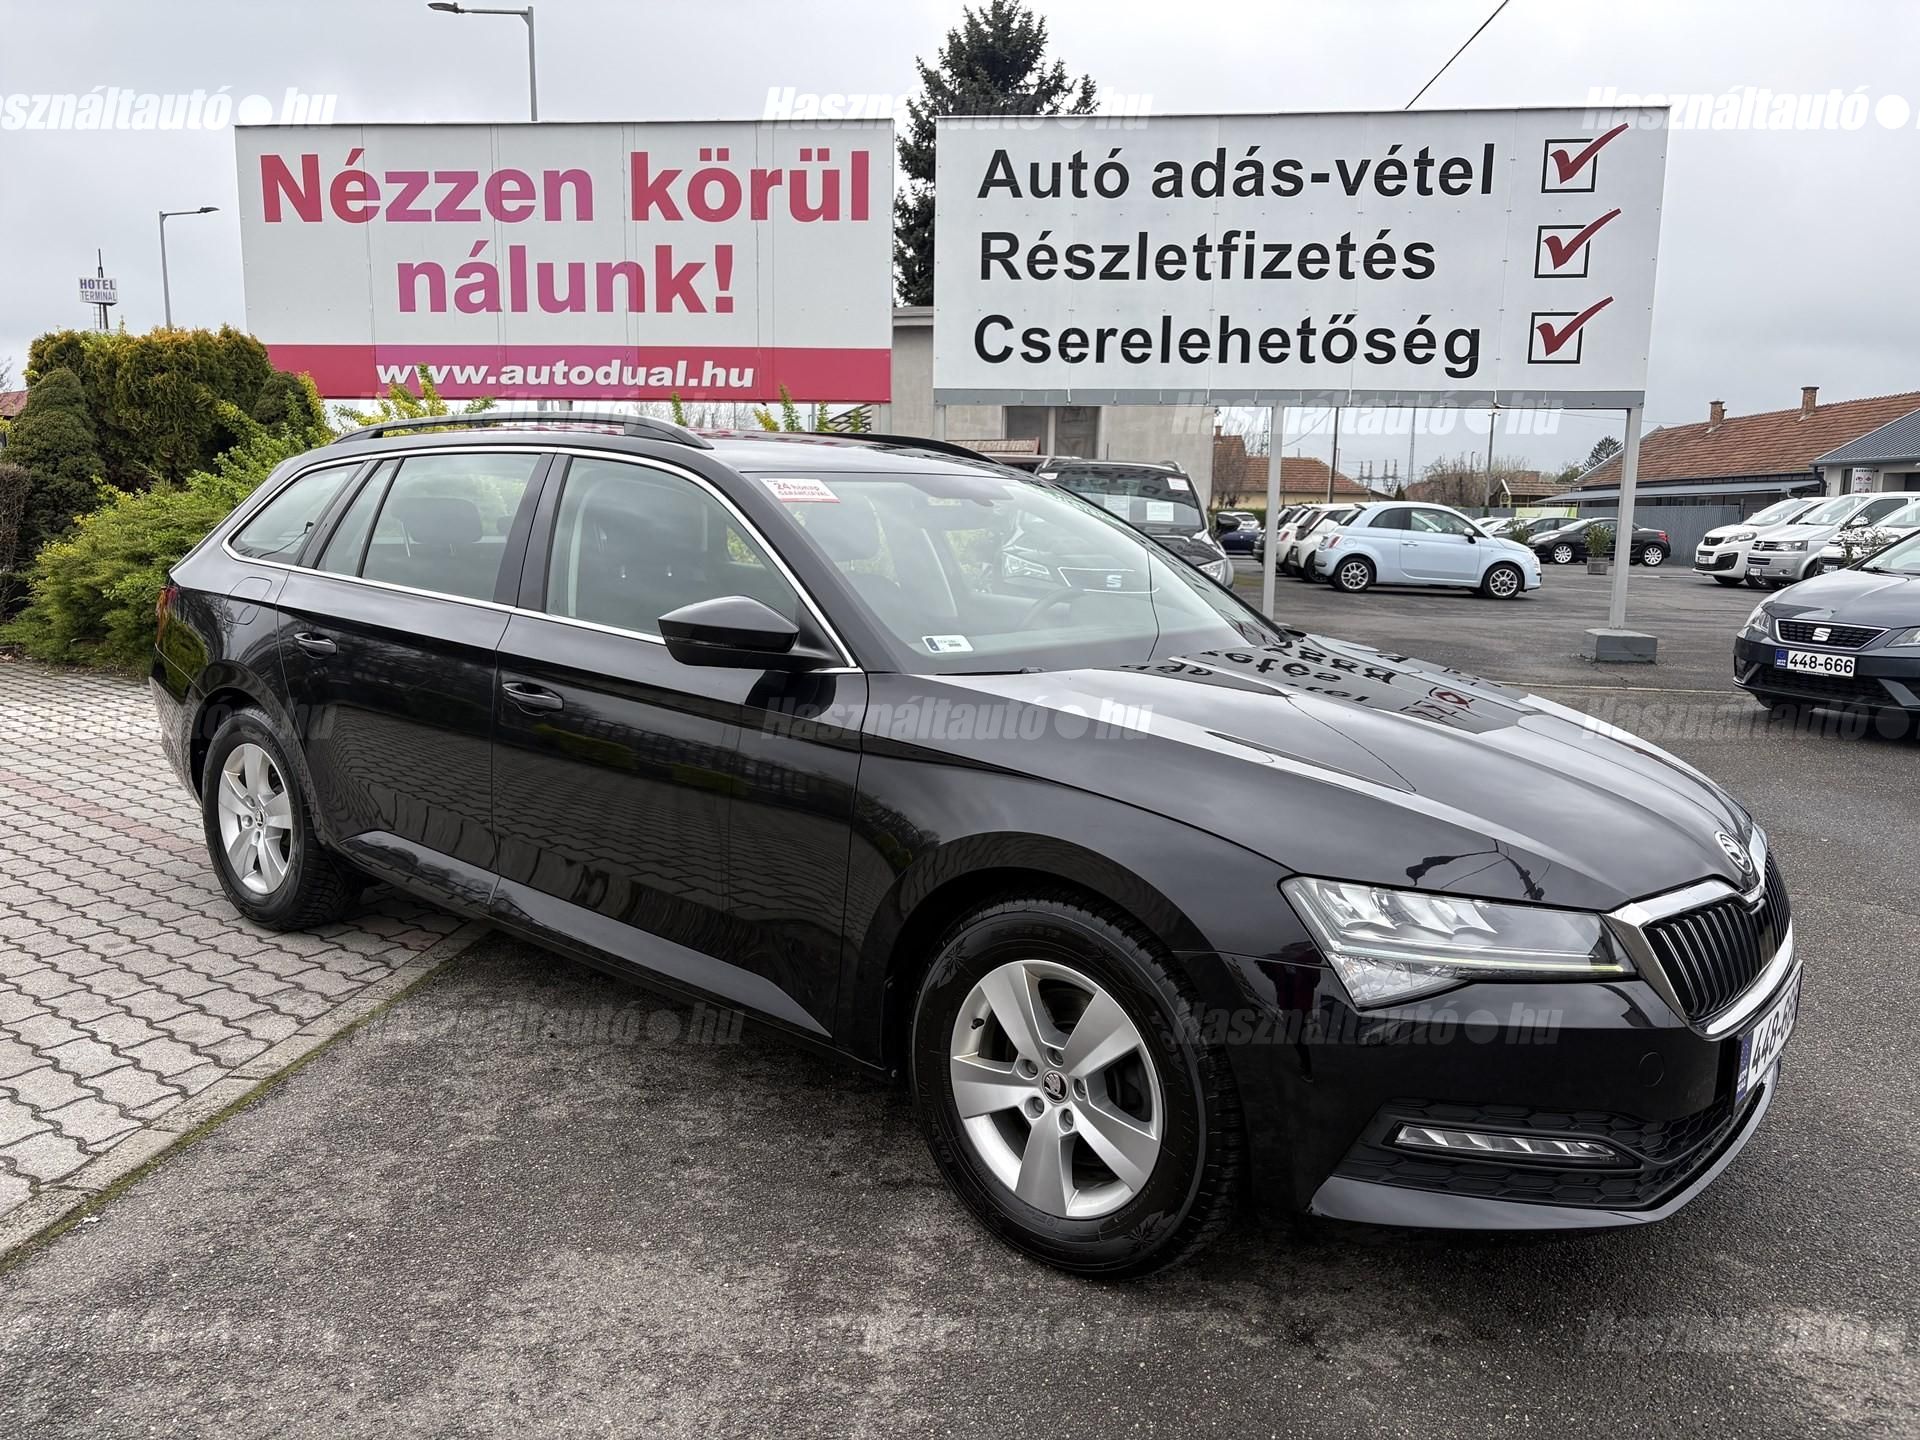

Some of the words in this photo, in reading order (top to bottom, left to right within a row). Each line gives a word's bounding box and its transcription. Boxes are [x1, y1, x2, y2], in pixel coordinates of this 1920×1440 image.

[260, 148, 594, 224] Nézzen
[630, 148, 871, 222] körül
[977, 146, 1131, 200] Autó
[1150, 142, 1496, 199] adás-vétel
[397, 239, 735, 314] nálunk!
[979, 228, 1437, 281] Részletfizetés
[80, 278, 116, 290] HOTEL
[80, 290, 117, 301] TERMINAL
[973, 313, 1481, 379] Cserelehetőség
[375, 360, 755, 389] www.autodual.hu
[1789, 653, 1855, 674] 448-666
